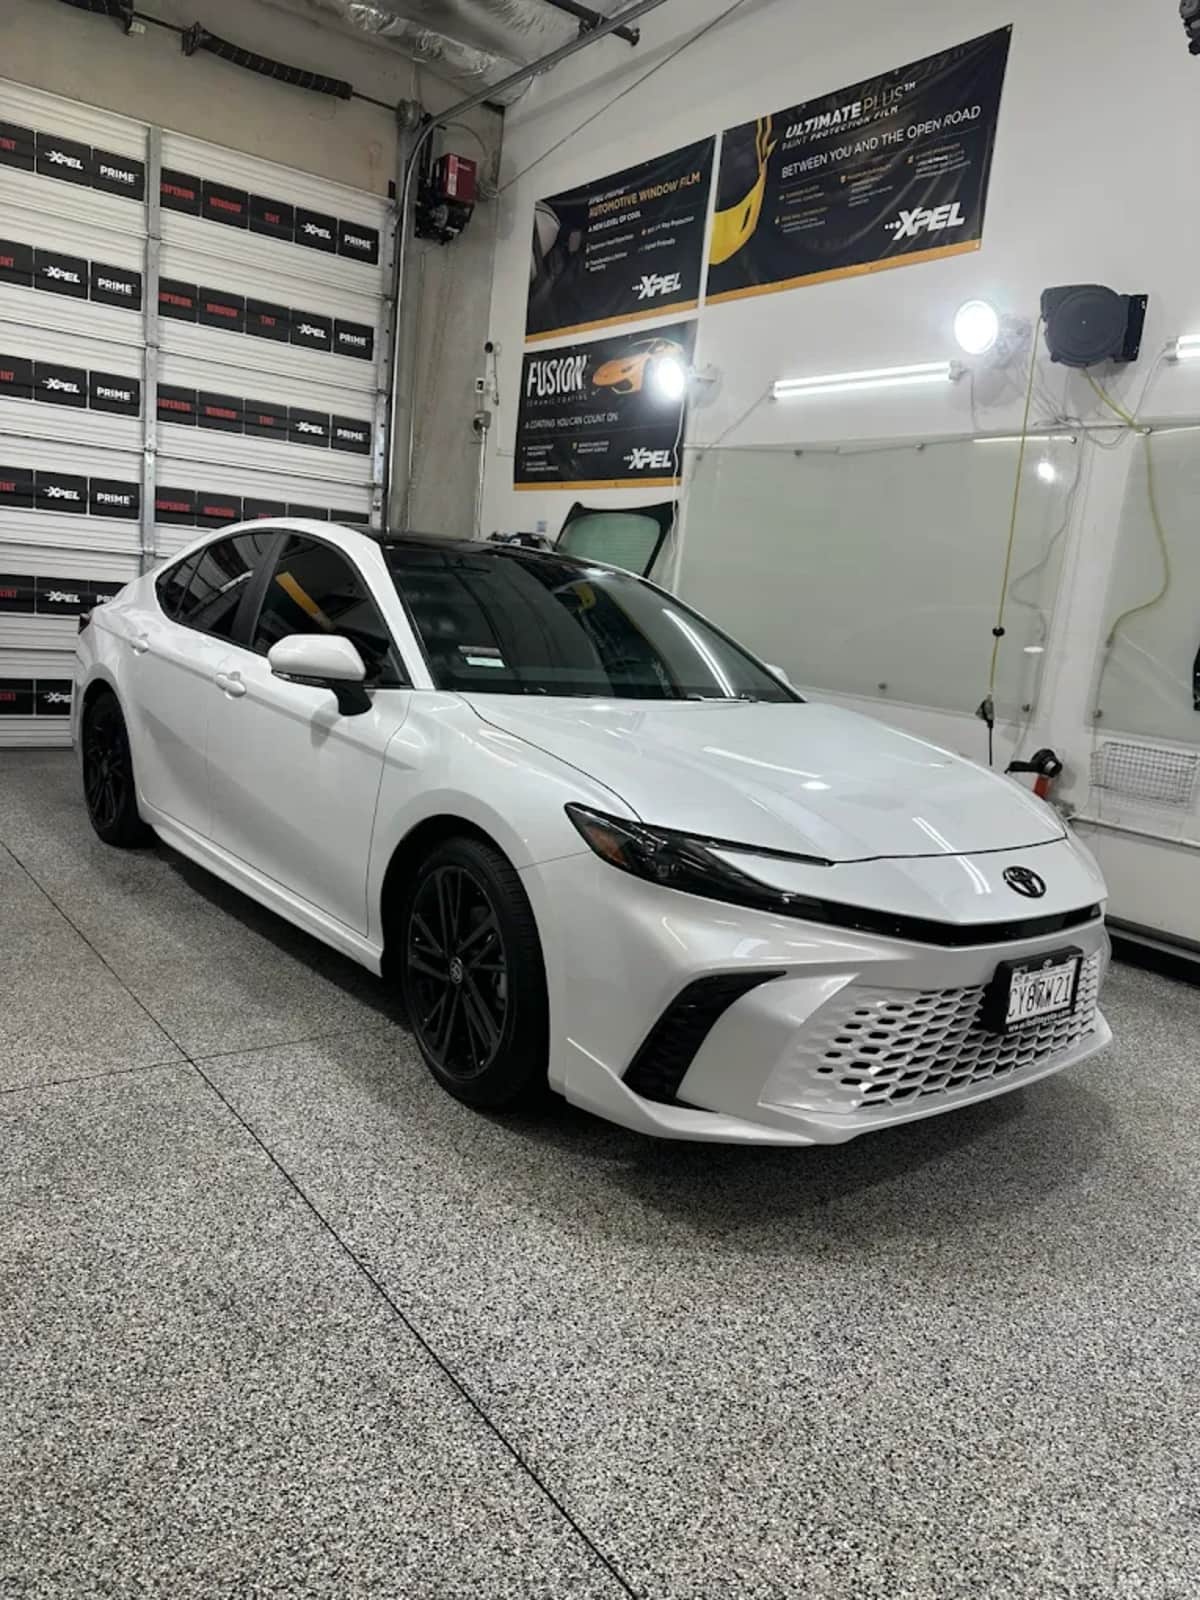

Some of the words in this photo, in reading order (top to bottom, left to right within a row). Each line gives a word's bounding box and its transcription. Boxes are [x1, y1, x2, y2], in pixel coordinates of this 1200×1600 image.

[782, 152, 828, 178] BETWEEN
[830, 144, 853, 161] YOU
[855, 137, 879, 155] AND
[881, 129, 905, 145] THE
[907, 118, 942, 139] OPEN
[943, 105, 981, 128] ROAD
[49, 150, 84, 170] XPEL
[99, 165, 136, 183] PRIME
[588, 192, 638, 218] AUTOMOTIVE
[639, 180, 678, 201] WINDOW
[679, 171, 701, 189] FILM
[893, 202, 965, 240] XPEL
[344, 234, 371, 250] PRIME
[47, 266, 81, 283] XPEL
[97, 278, 132, 294] PRIME
[638, 272, 682, 300] XPEL
[339, 332, 366, 346] PRIME
[527, 355, 587, 397] FUSION
[47, 378, 80, 393] XPEL
[97, 387, 130, 400] PRIME
[337, 428, 364, 441] PRIME
[629, 447, 672, 469] XPEL
[47, 486, 80, 500] XPEL
[97, 493, 130, 505] PRIME
[48, 591, 80, 603] XPEL
[48, 691, 73, 703] XPE
